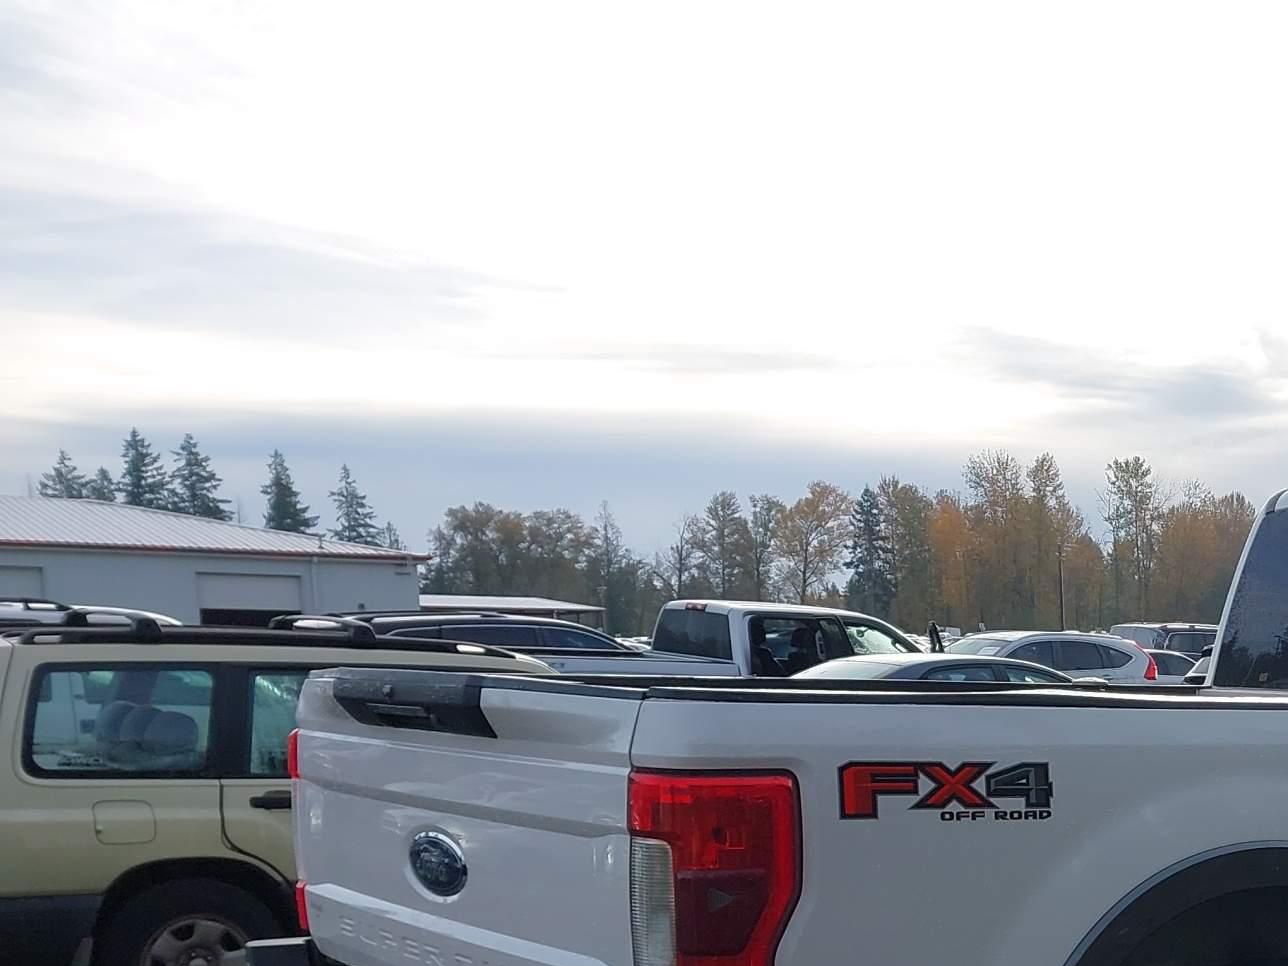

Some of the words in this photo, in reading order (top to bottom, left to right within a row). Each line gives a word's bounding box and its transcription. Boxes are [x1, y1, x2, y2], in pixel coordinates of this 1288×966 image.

[837, 759, 1054, 821] FX4
[940, 810, 986, 822] OFF
[993, 809, 1053, 821] ROAD
